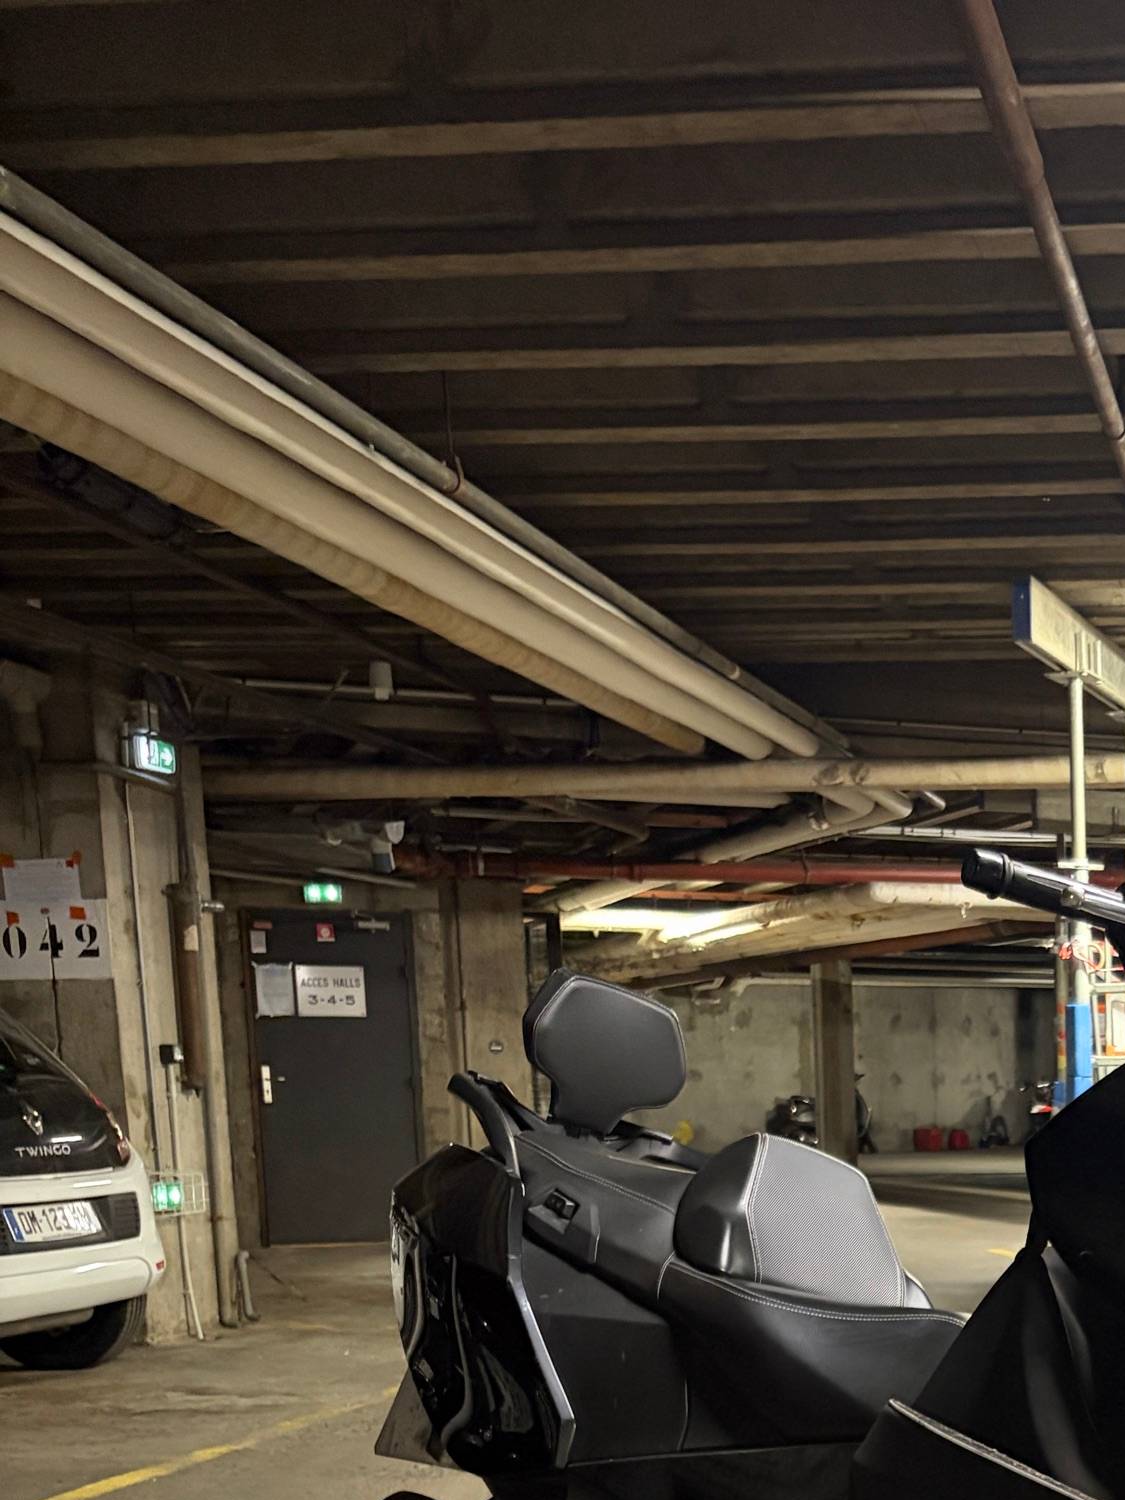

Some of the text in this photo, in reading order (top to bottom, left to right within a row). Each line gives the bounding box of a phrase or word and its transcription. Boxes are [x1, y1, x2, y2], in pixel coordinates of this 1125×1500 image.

[2, 923, 100, 959] 042
[300, 977, 361, 989] ACCES HALLS
[14, 1144, 71, 1158] TWINGO
